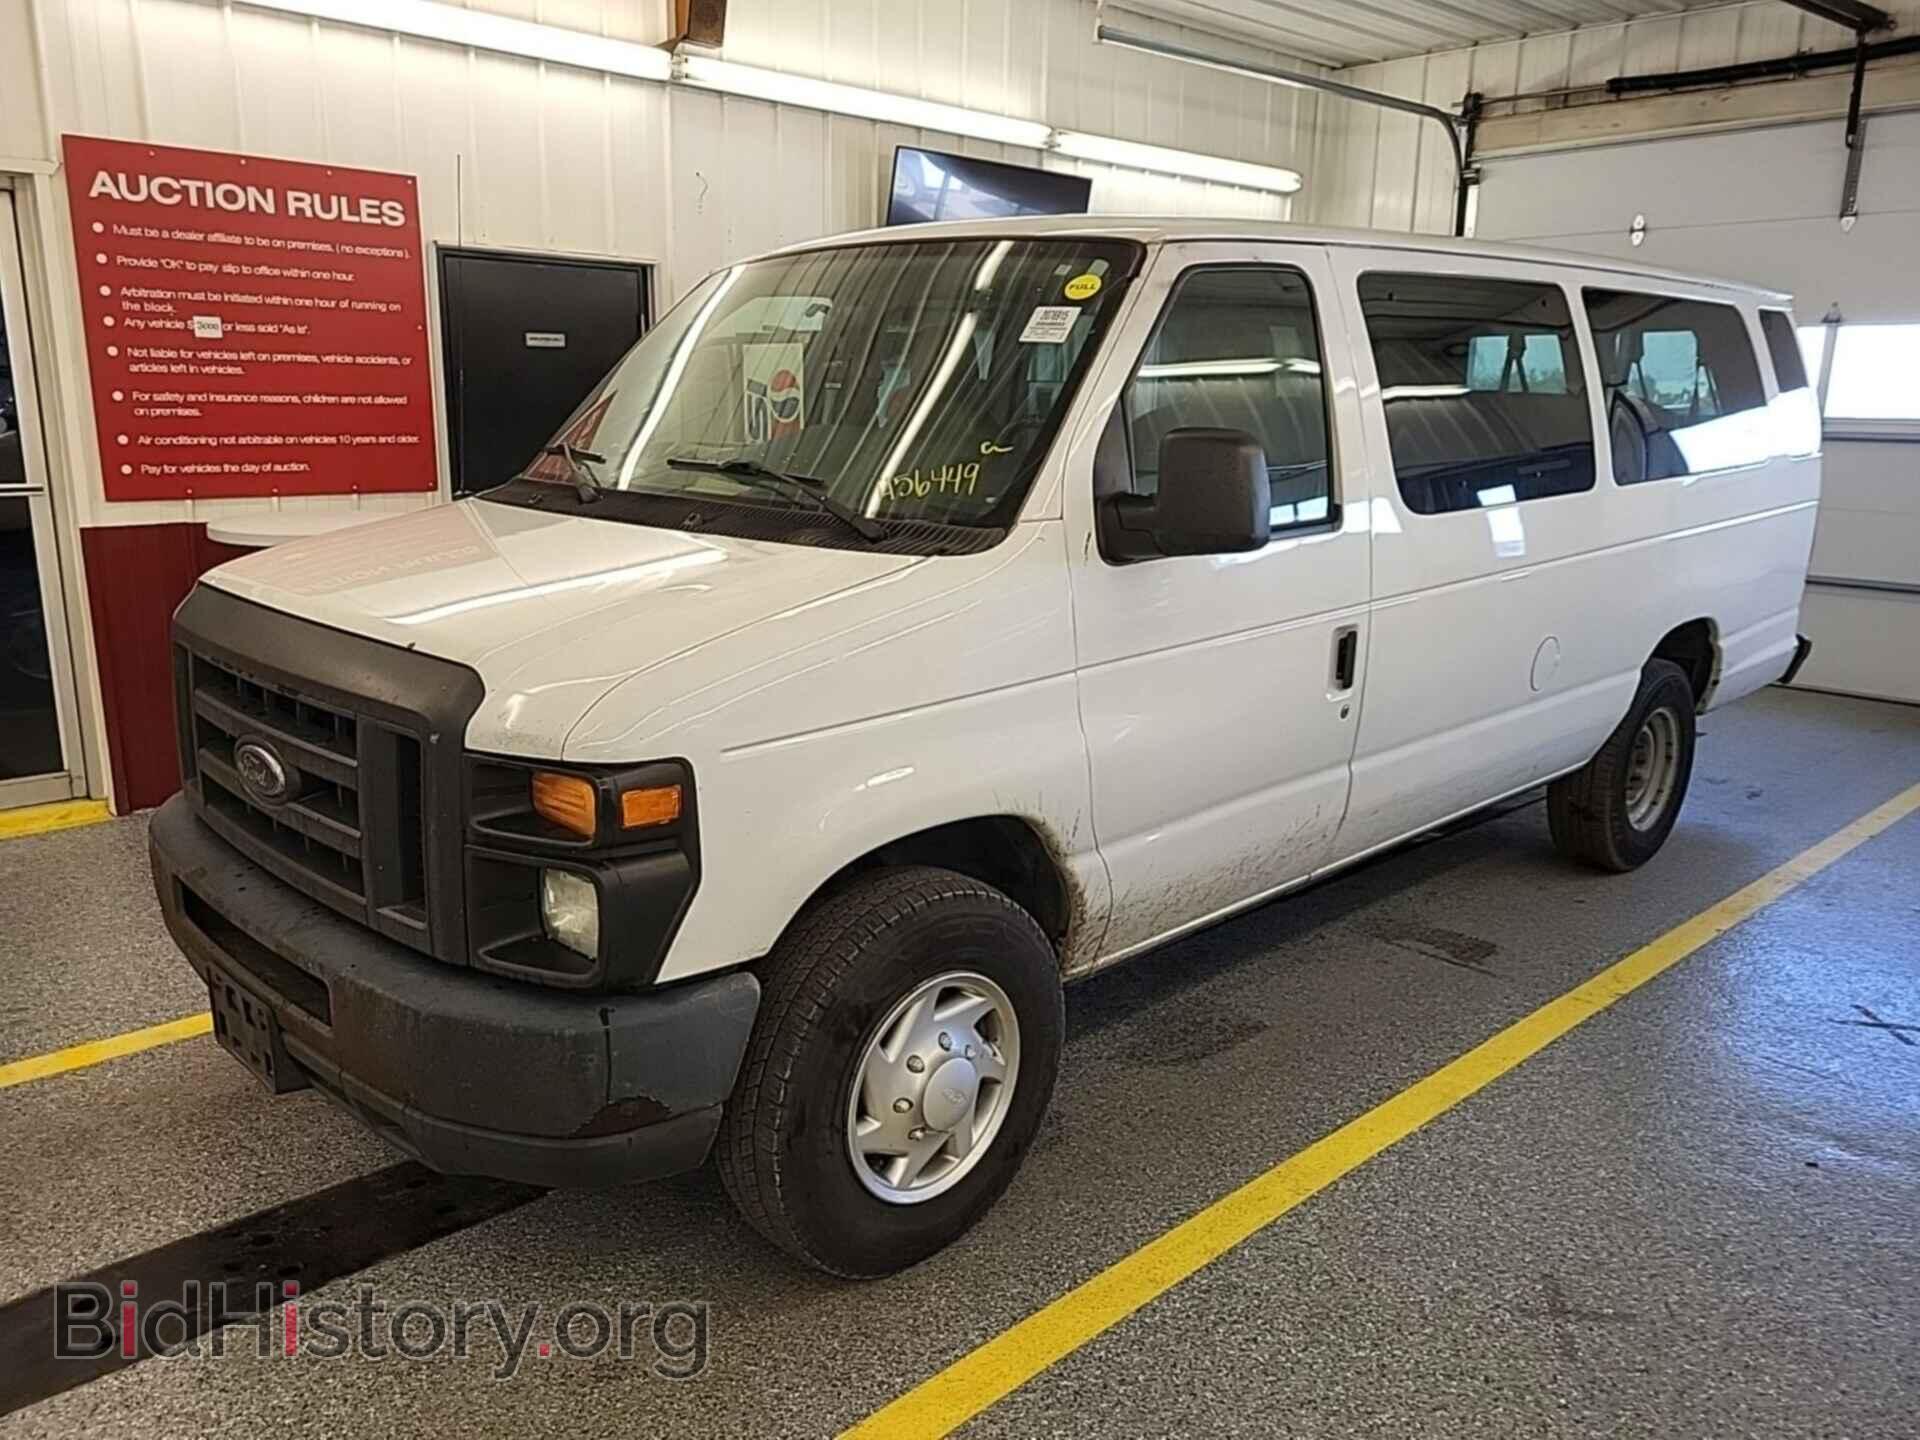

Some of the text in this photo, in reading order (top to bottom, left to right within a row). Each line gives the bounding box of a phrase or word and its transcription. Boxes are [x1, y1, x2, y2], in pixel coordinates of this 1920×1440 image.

[89, 171, 406, 227] AUCTION RULES
[113, 224, 142, 236] Must
[144, 227, 158, 237] be
[161, 229, 169, 238] a
[172, 229, 204, 241] dealer
[207, 232, 241, 244] affiliate
[244, 236, 255, 246] to
[257, 237, 269, 246] be
[272, 239, 285, 248] on
[341, 244, 353, 253] no
[117, 256, 158, 268] Provide
[186, 262, 196, 271] to
[198, 262, 218, 273] pay
[222, 264, 239, 274] slip
[242, 266, 253, 274] to
[254, 266, 280, 275] office
[282, 268, 310, 278] within
[121, 287, 401, 312] Arbitration must be initiated within one hour of running on
[122, 301, 140, 311] the
[125, 318, 145, 330] Any
[148, 319, 184, 329] vehicle
[236, 322, 255, 332] less
[258, 325, 278, 333] sold
[128, 348, 148, 358] Not
[150, 348, 177, 358] liable
[180, 350, 193, 358] for
[197, 350, 238, 360] vehicles
[240, 350, 255, 360] left
[257, 353, 270, 361] on
[321, 354, 353, 363] vehicle
[129, 363, 168, 373] articles
[170, 363, 187, 373] left
[190, 364, 199, 373] in
[133, 392, 150, 401] For
[153, 392, 184, 403] safety
[187, 393, 207, 401] and
[210, 393, 258, 402] insurance
[303, 394, 339, 404] children
[341, 396, 356, 404] are
[358, 396, 371, 404] not
[374, 396, 407, 405] allowed
[134, 408, 149, 416] on
[138, 436, 153, 444] Air
[155, 435, 217, 446] conditioning
[219, 436, 236, 444] not
[238, 434, 283, 444] arbitrable
[301, 434, 336, 444] vehicles
[339, 435, 350, 443] 10
[352, 436, 376, 445] years
[378, 435, 395, 443] and
[141, 464, 161, 475] Pay
[164, 464, 178, 473] for
[180, 463, 221, 473] vehicles
[224, 463, 239, 472] the
[242, 463, 260, 474] day
[262, 462, 272, 471] of
